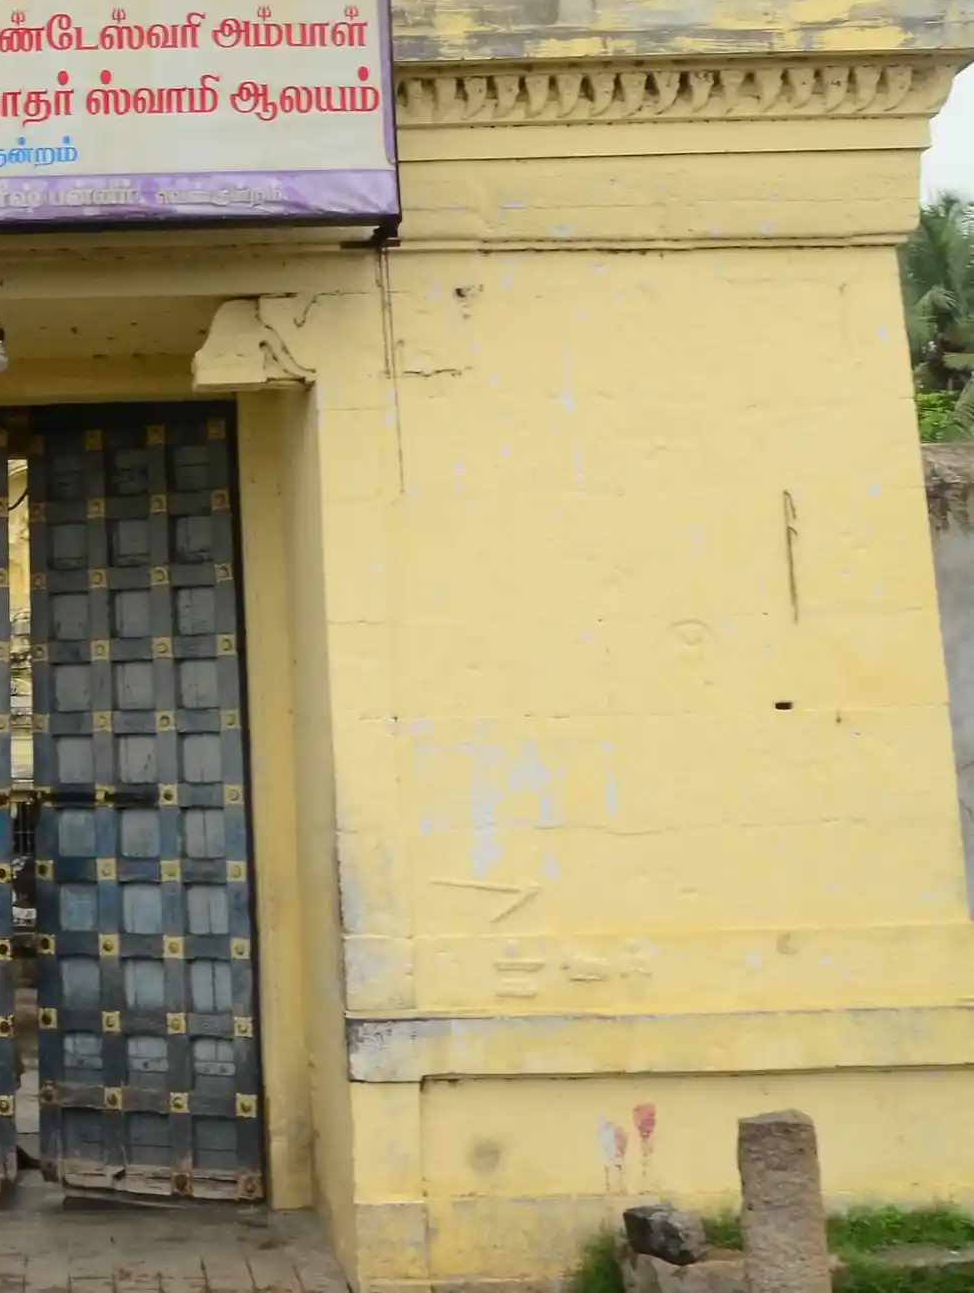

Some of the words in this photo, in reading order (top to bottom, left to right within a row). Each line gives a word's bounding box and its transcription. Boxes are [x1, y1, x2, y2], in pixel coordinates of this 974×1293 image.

[211, 5, 369, 49] அம்பாள்
[85, 69, 221, 116] ஸ்வாமி
[229, 66, 381, 122] ஆலயம்
